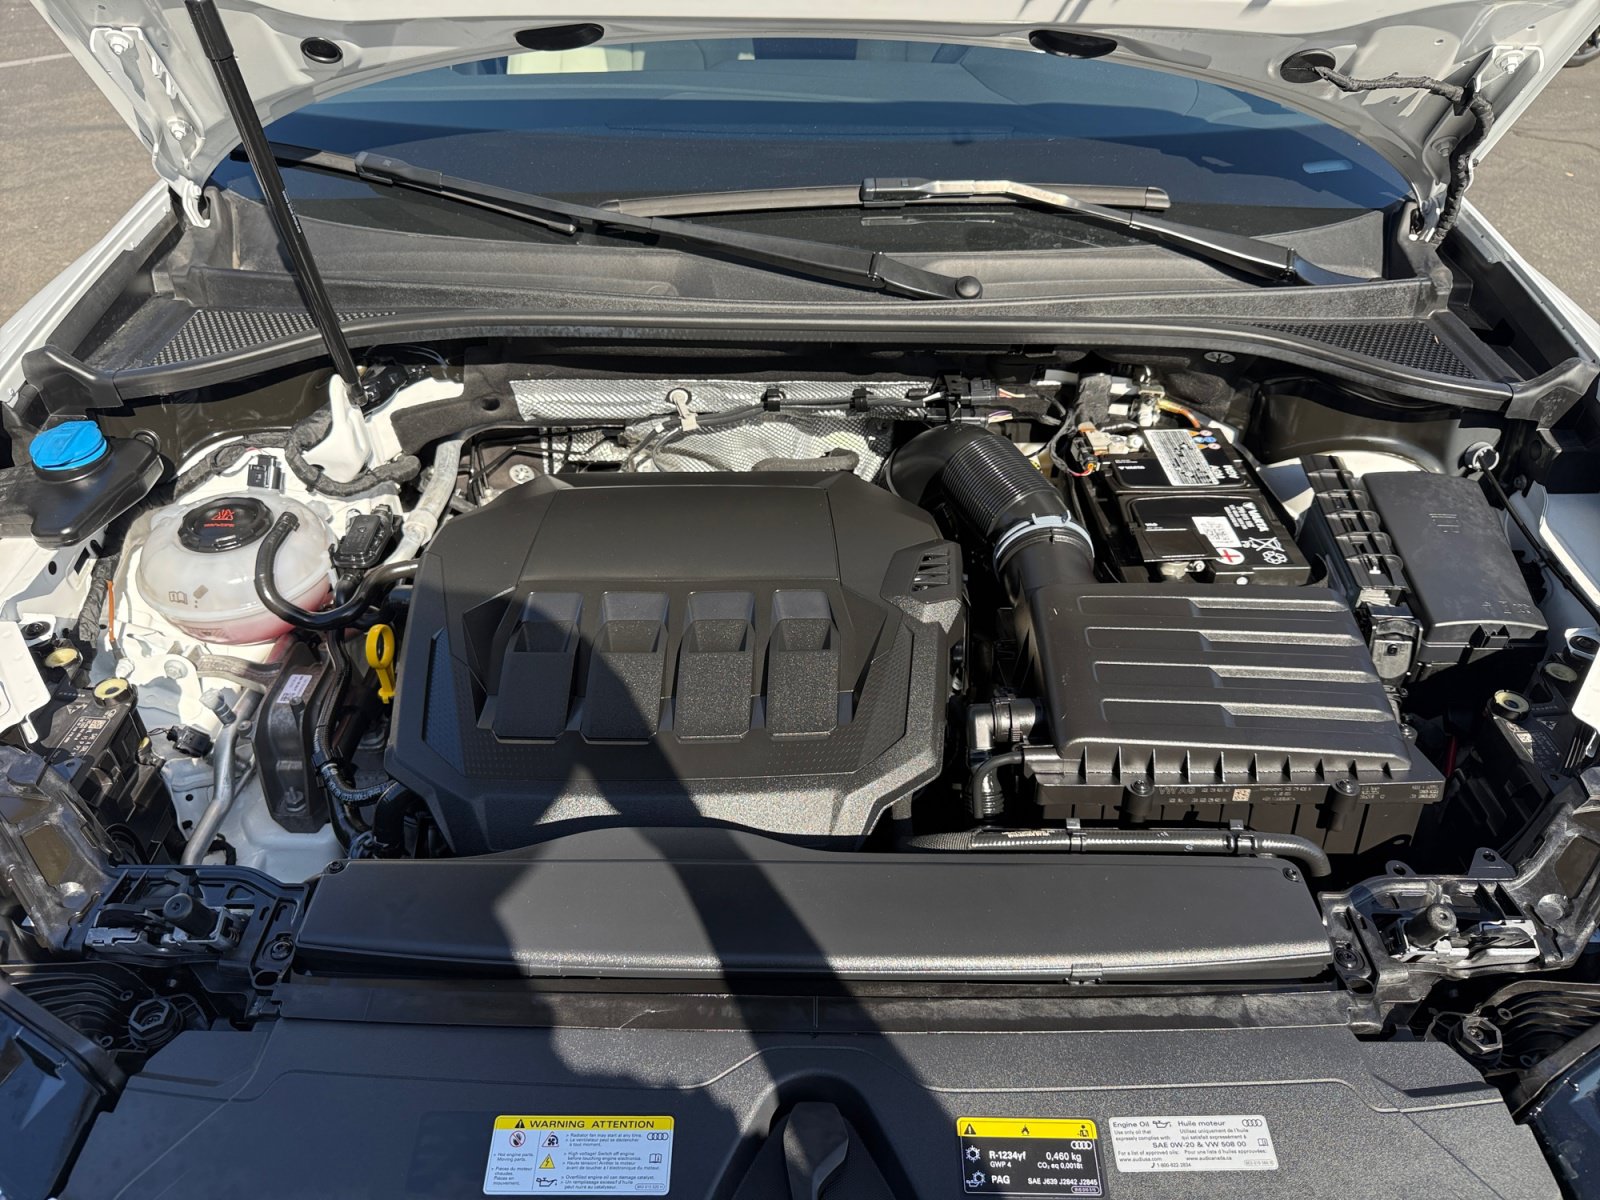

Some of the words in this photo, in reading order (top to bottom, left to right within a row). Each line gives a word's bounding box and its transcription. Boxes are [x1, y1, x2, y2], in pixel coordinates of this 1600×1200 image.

[1248, 510, 1269, 532] VARTA
[529, 1120, 585, 1128] WARNING
[591, 1120, 655, 1128] ATTENTION
[989, 1151, 1026, 1162] R-1234yf
[1046, 1152, 1070, 1161] 0,460
[1071, 1152, 1082, 1162] kg
[991, 1176, 1011, 1184] PAG
